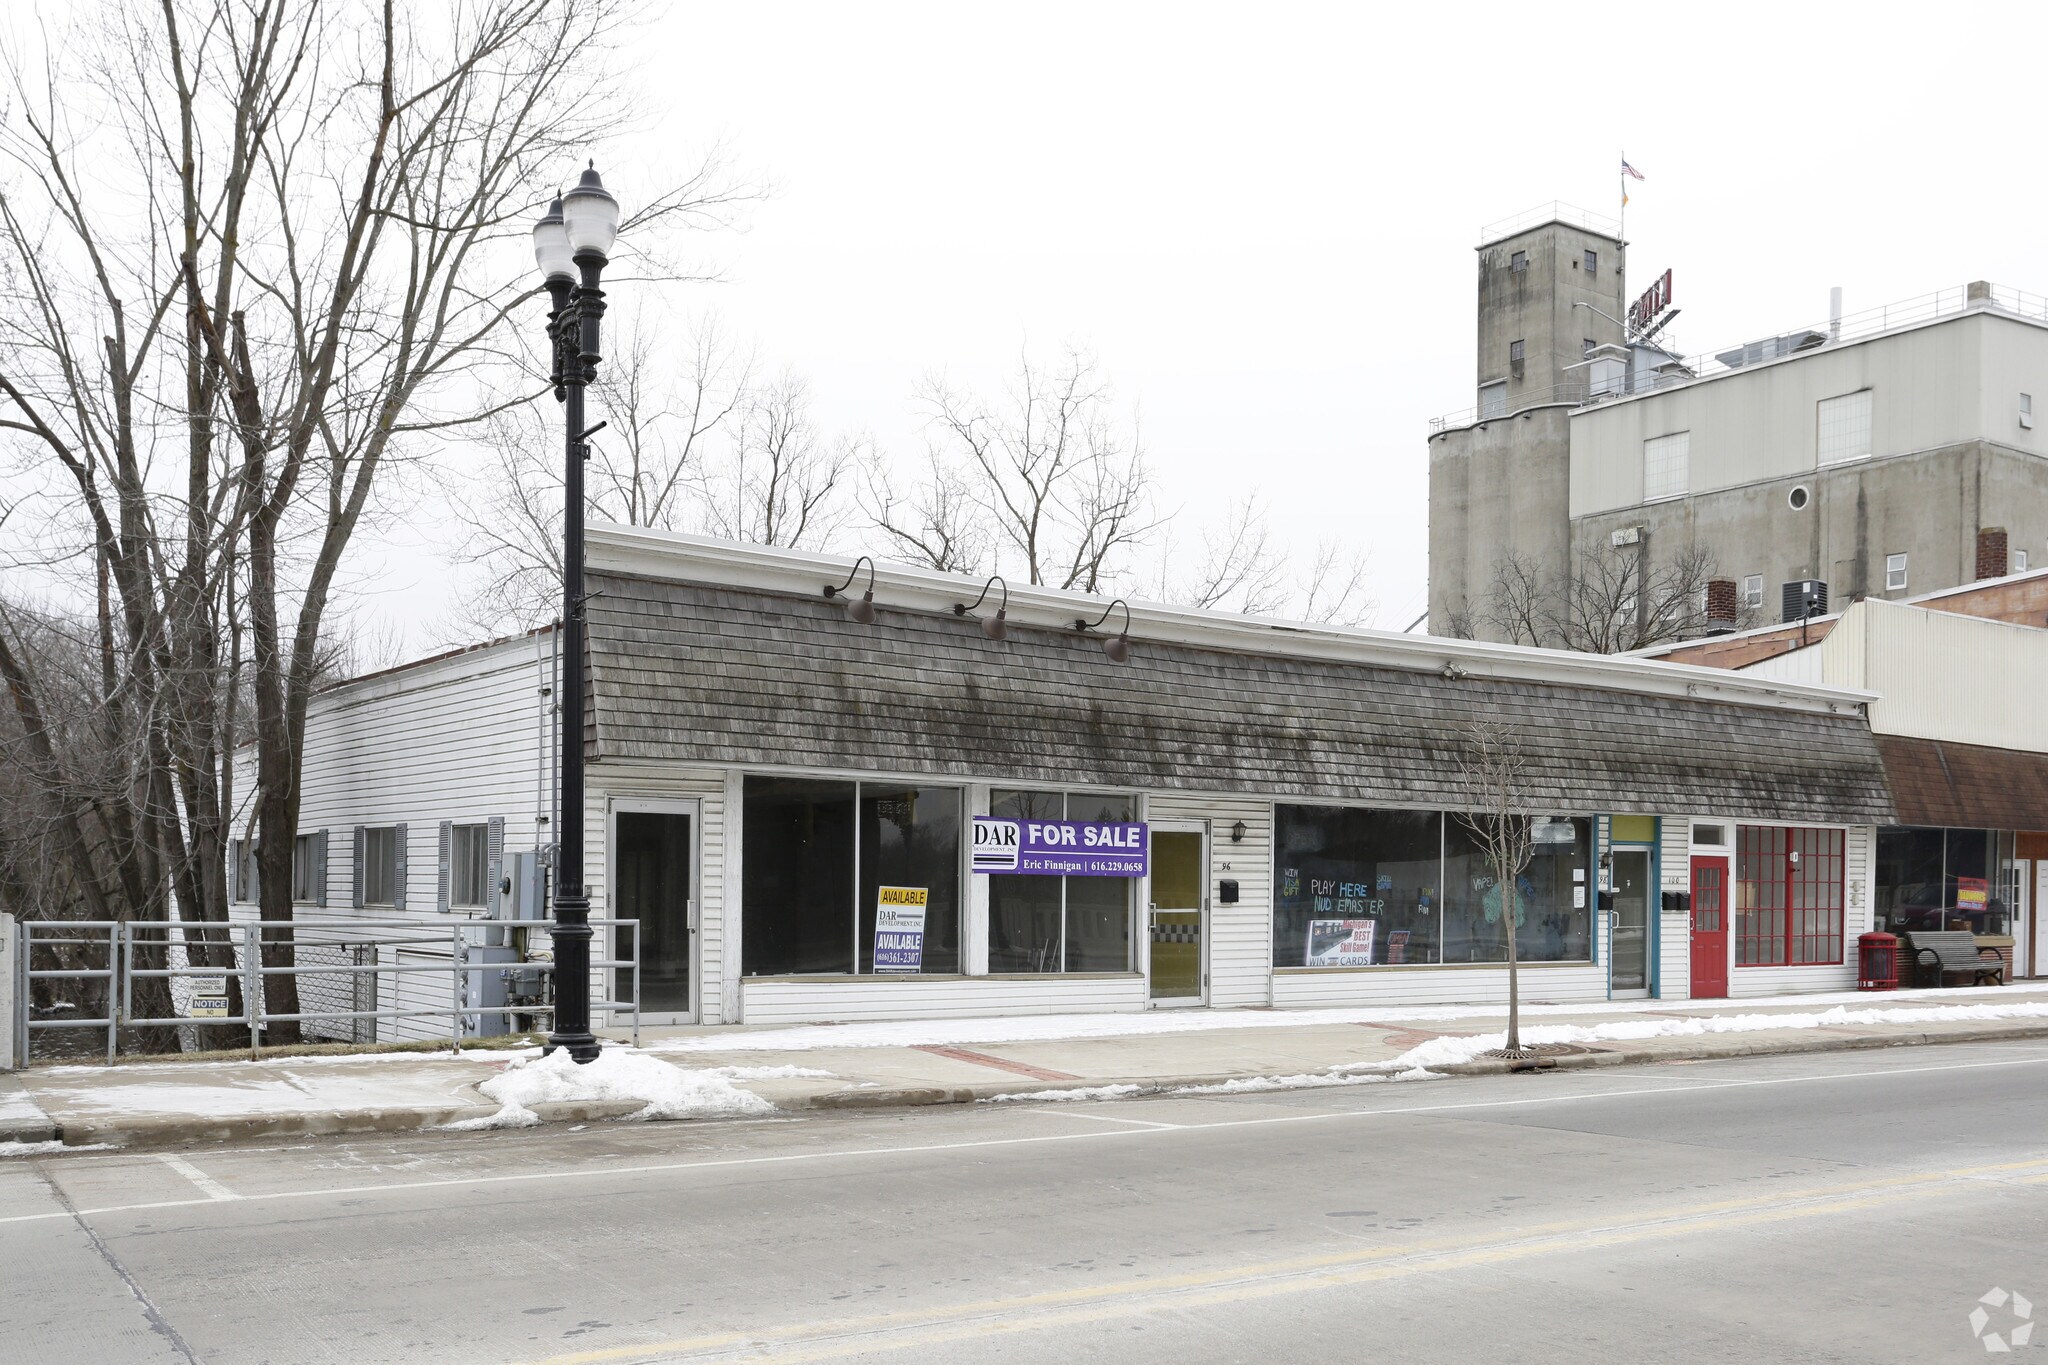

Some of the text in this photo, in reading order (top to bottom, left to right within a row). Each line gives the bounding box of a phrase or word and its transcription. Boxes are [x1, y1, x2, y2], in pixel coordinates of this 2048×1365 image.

[974, 824, 1016, 846] DAR
[1028, 823, 1141, 848] FOR SALE
[1023, 859, 1143, 872] Eric Finnigan 616.229.0658
[1221, 861, 1232, 871] 96
[1284, 868, 1298, 878] WIN
[1311, 879, 1367, 898] PLAY HERE
[1472, 876, 1494, 892] VAPE!
[881, 890, 925, 904] AVAILABLE
[1283, 886, 1299, 897] GIFT
[880, 911, 897, 920] DAR
[877, 933, 921, 950] AVAILABLE
[1353, 931, 1371, 941] BEST
[1310, 957, 1326, 966] WIN
[1340, 956, 1368, 966] CARDS
[194, 1000, 226, 1008] NOTICE
